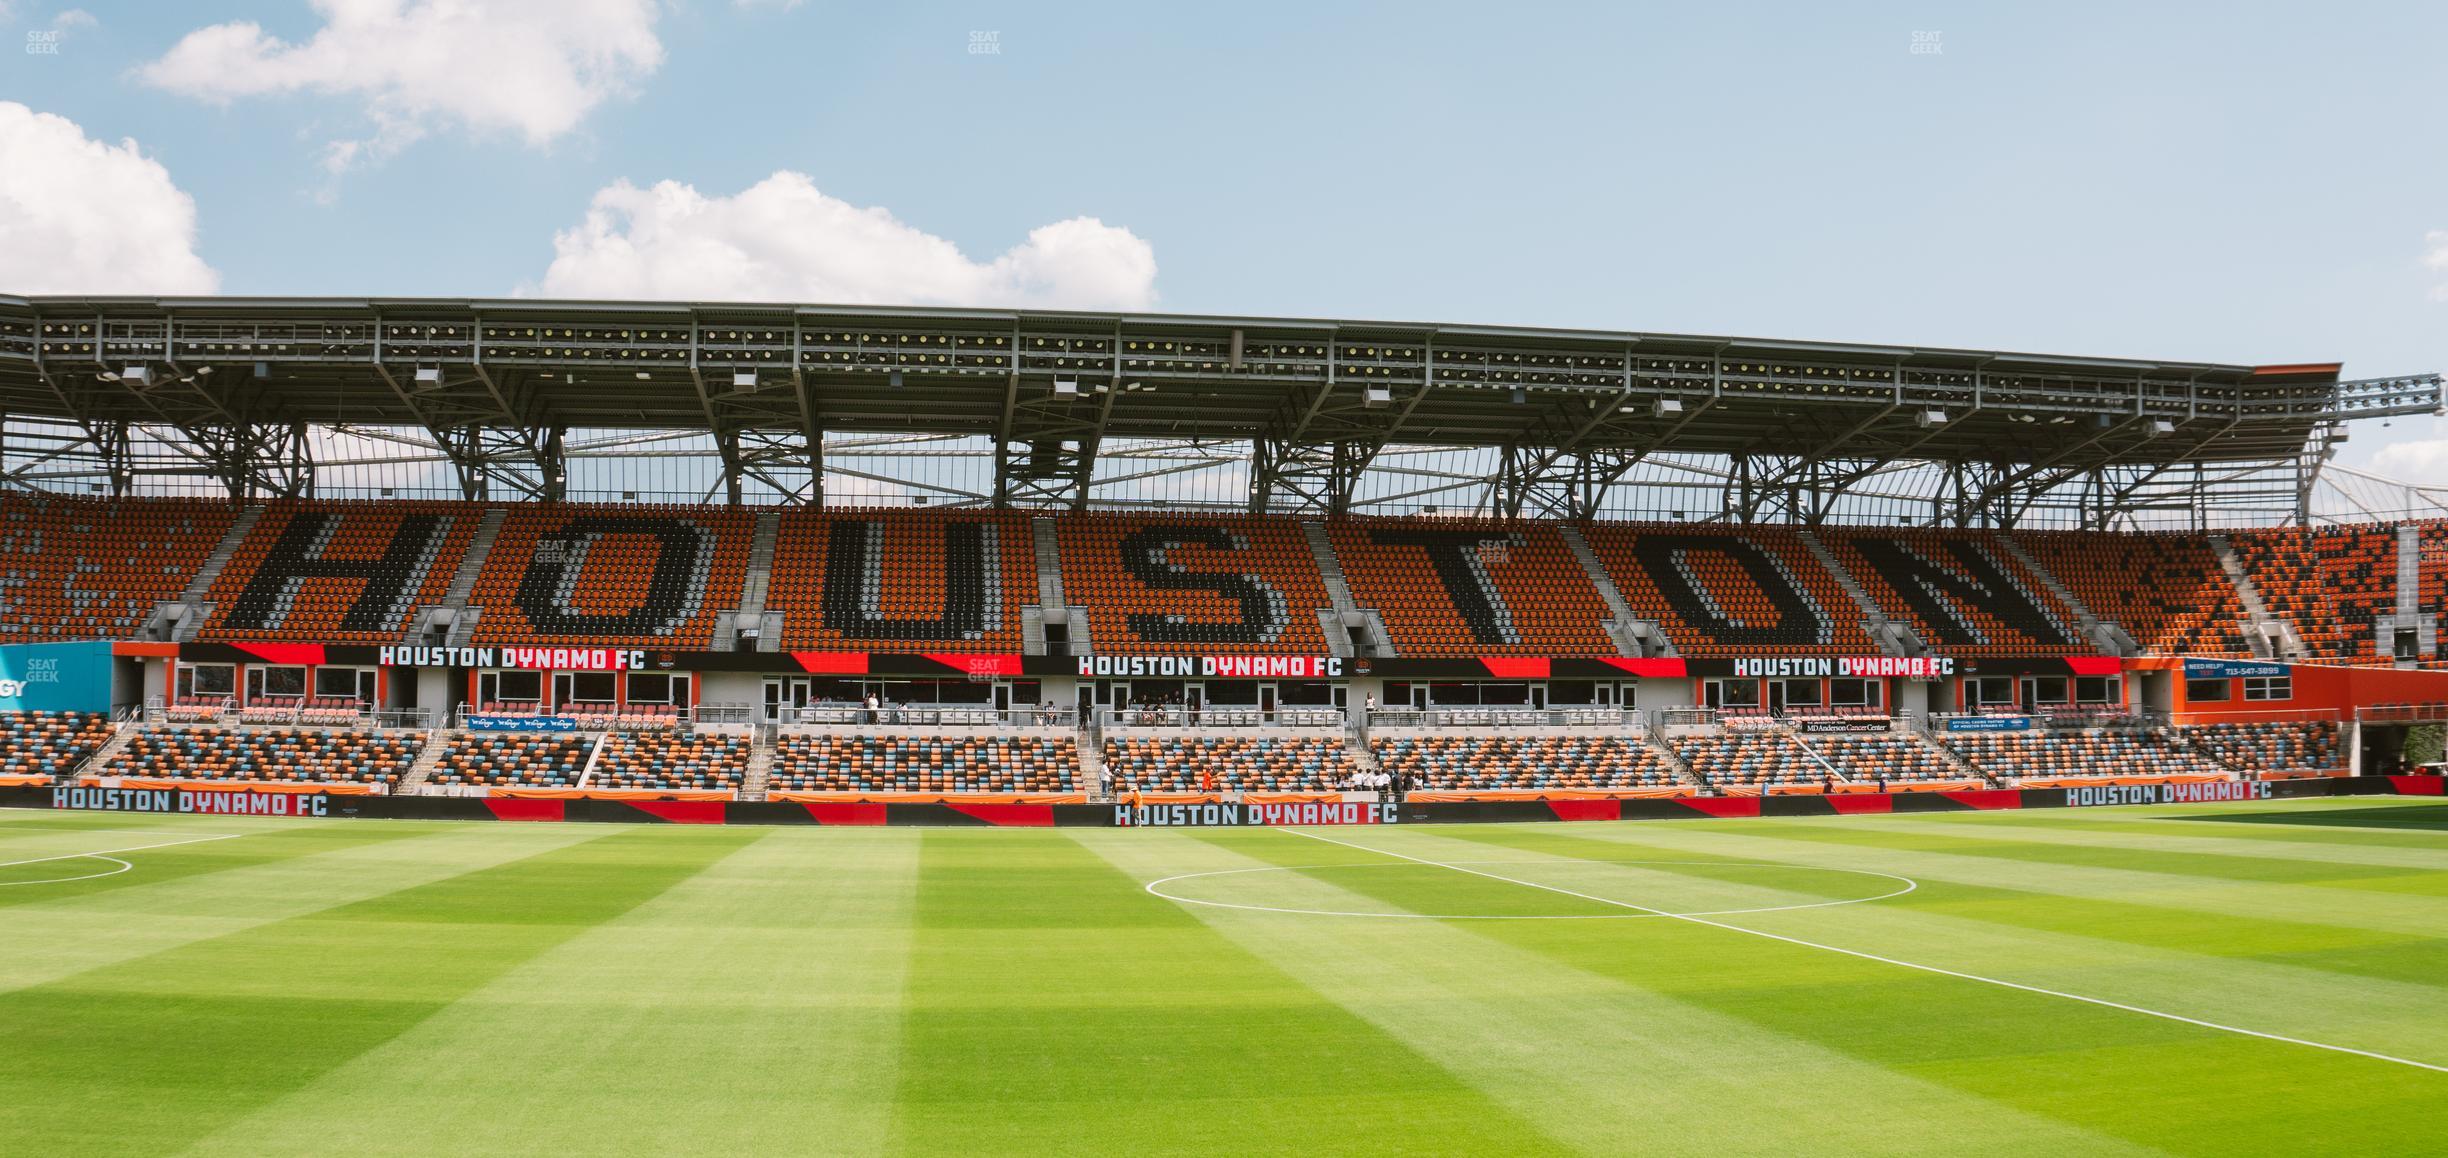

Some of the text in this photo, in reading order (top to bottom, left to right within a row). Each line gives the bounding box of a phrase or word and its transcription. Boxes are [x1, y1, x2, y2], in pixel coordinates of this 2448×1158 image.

[380, 646, 645, 670] HOUSTON DYNAMO FC
[1078, 656, 1342, 676] HOUSTON DYNAMO FC
[1734, 658, 1832, 676] HOUSTON
[1838, 658, 1924, 676] DYNAMO
[1930, 658, 1954, 676] FC
[53, 788, 327, 816] HOUSTON DYNAMO FC
[2066, 782, 2272, 806] HOUSTON DYNAMO FC
[1115, 804, 1398, 825] HOUSTON DYNAMO FC
